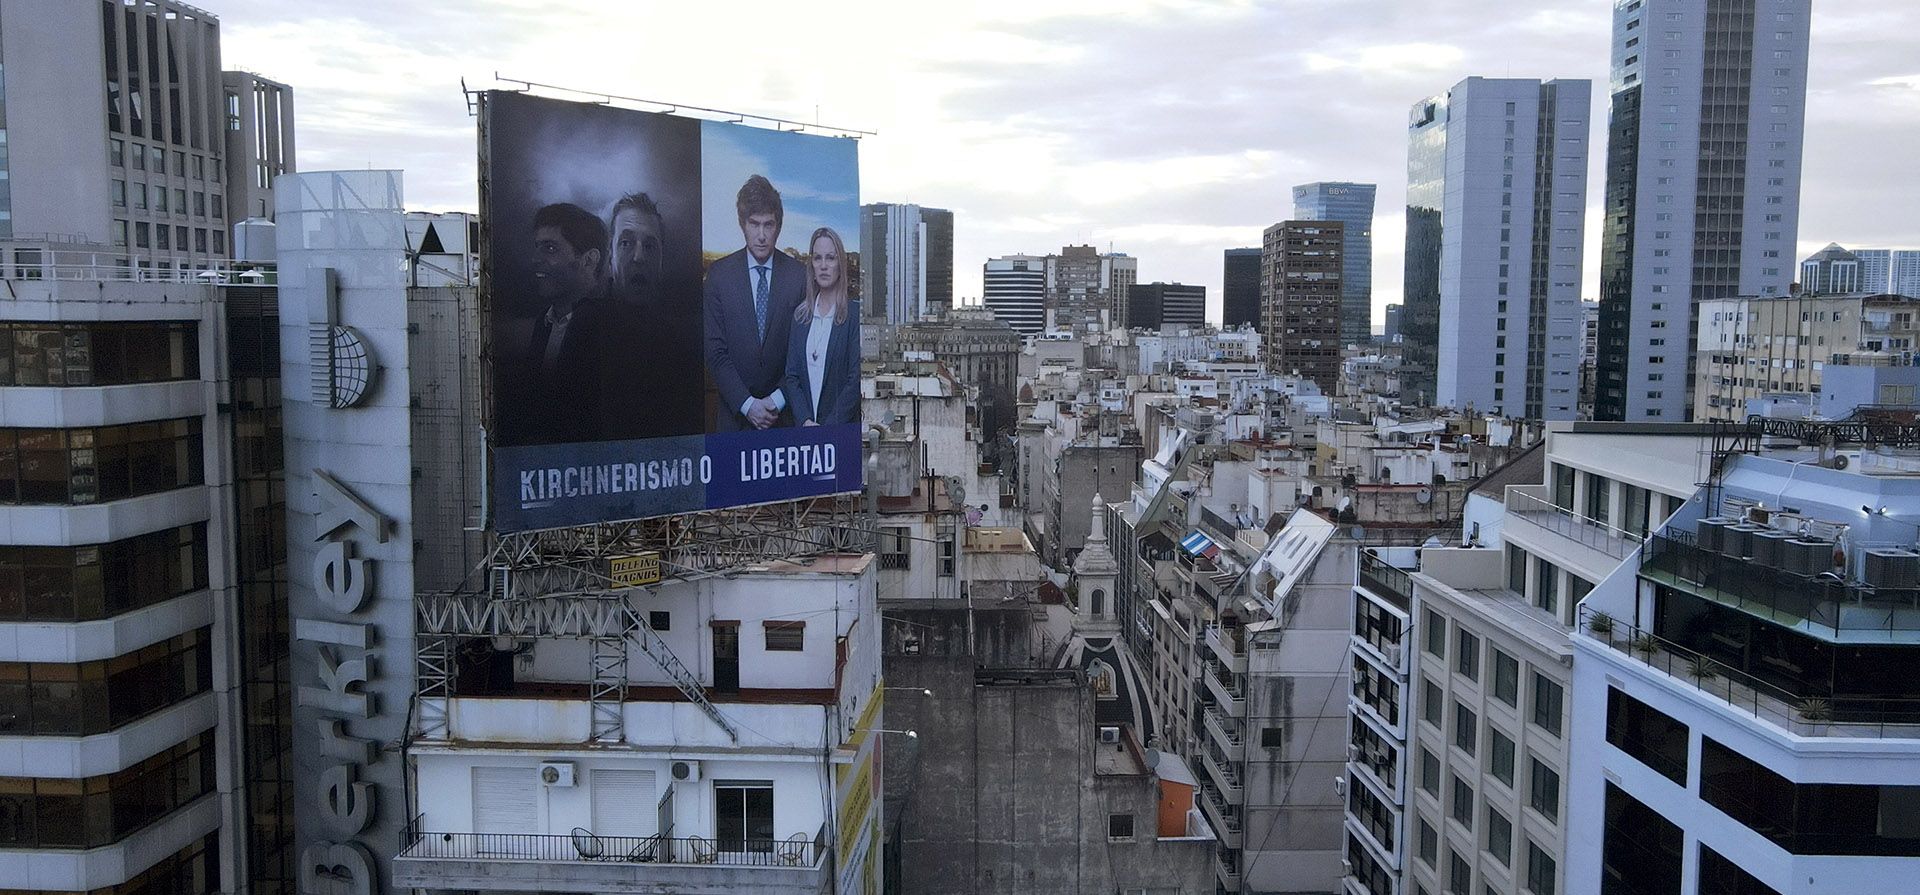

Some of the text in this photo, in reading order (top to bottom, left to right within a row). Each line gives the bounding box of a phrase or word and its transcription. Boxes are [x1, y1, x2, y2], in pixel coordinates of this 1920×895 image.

[1328, 187, 1349, 195] BBVA
[520, 443, 836, 501] KIRCHNERISMO O LIBERTAD
[613, 557, 658, 571] DELFINO
[613, 570, 657, 582] MAGNUS
[296, 467, 389, 895] Berkley
